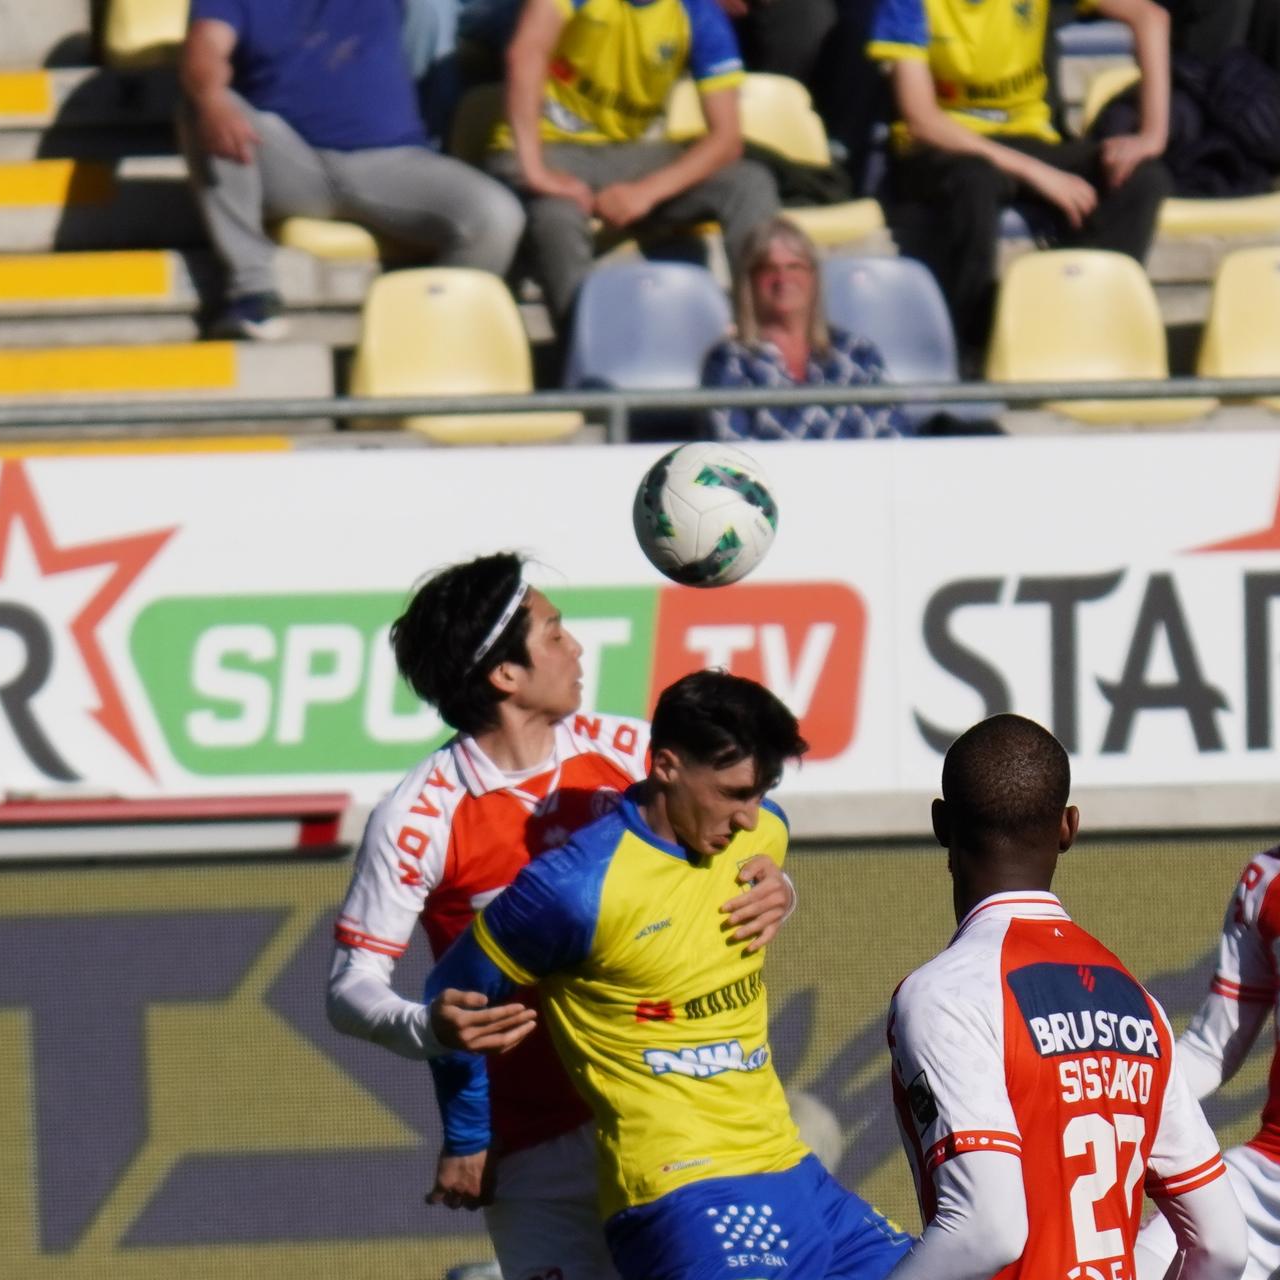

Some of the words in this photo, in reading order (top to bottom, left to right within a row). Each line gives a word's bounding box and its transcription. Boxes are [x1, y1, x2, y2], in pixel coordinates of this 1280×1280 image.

[185, 616, 631, 748] SPOT
[684, 620, 838, 722] TV
[1030, 1010, 1160, 1059] BRUSTOR
[1059, 1057, 1155, 1106] SISSAKO
[1062, 1112, 1147, 1264] 27
